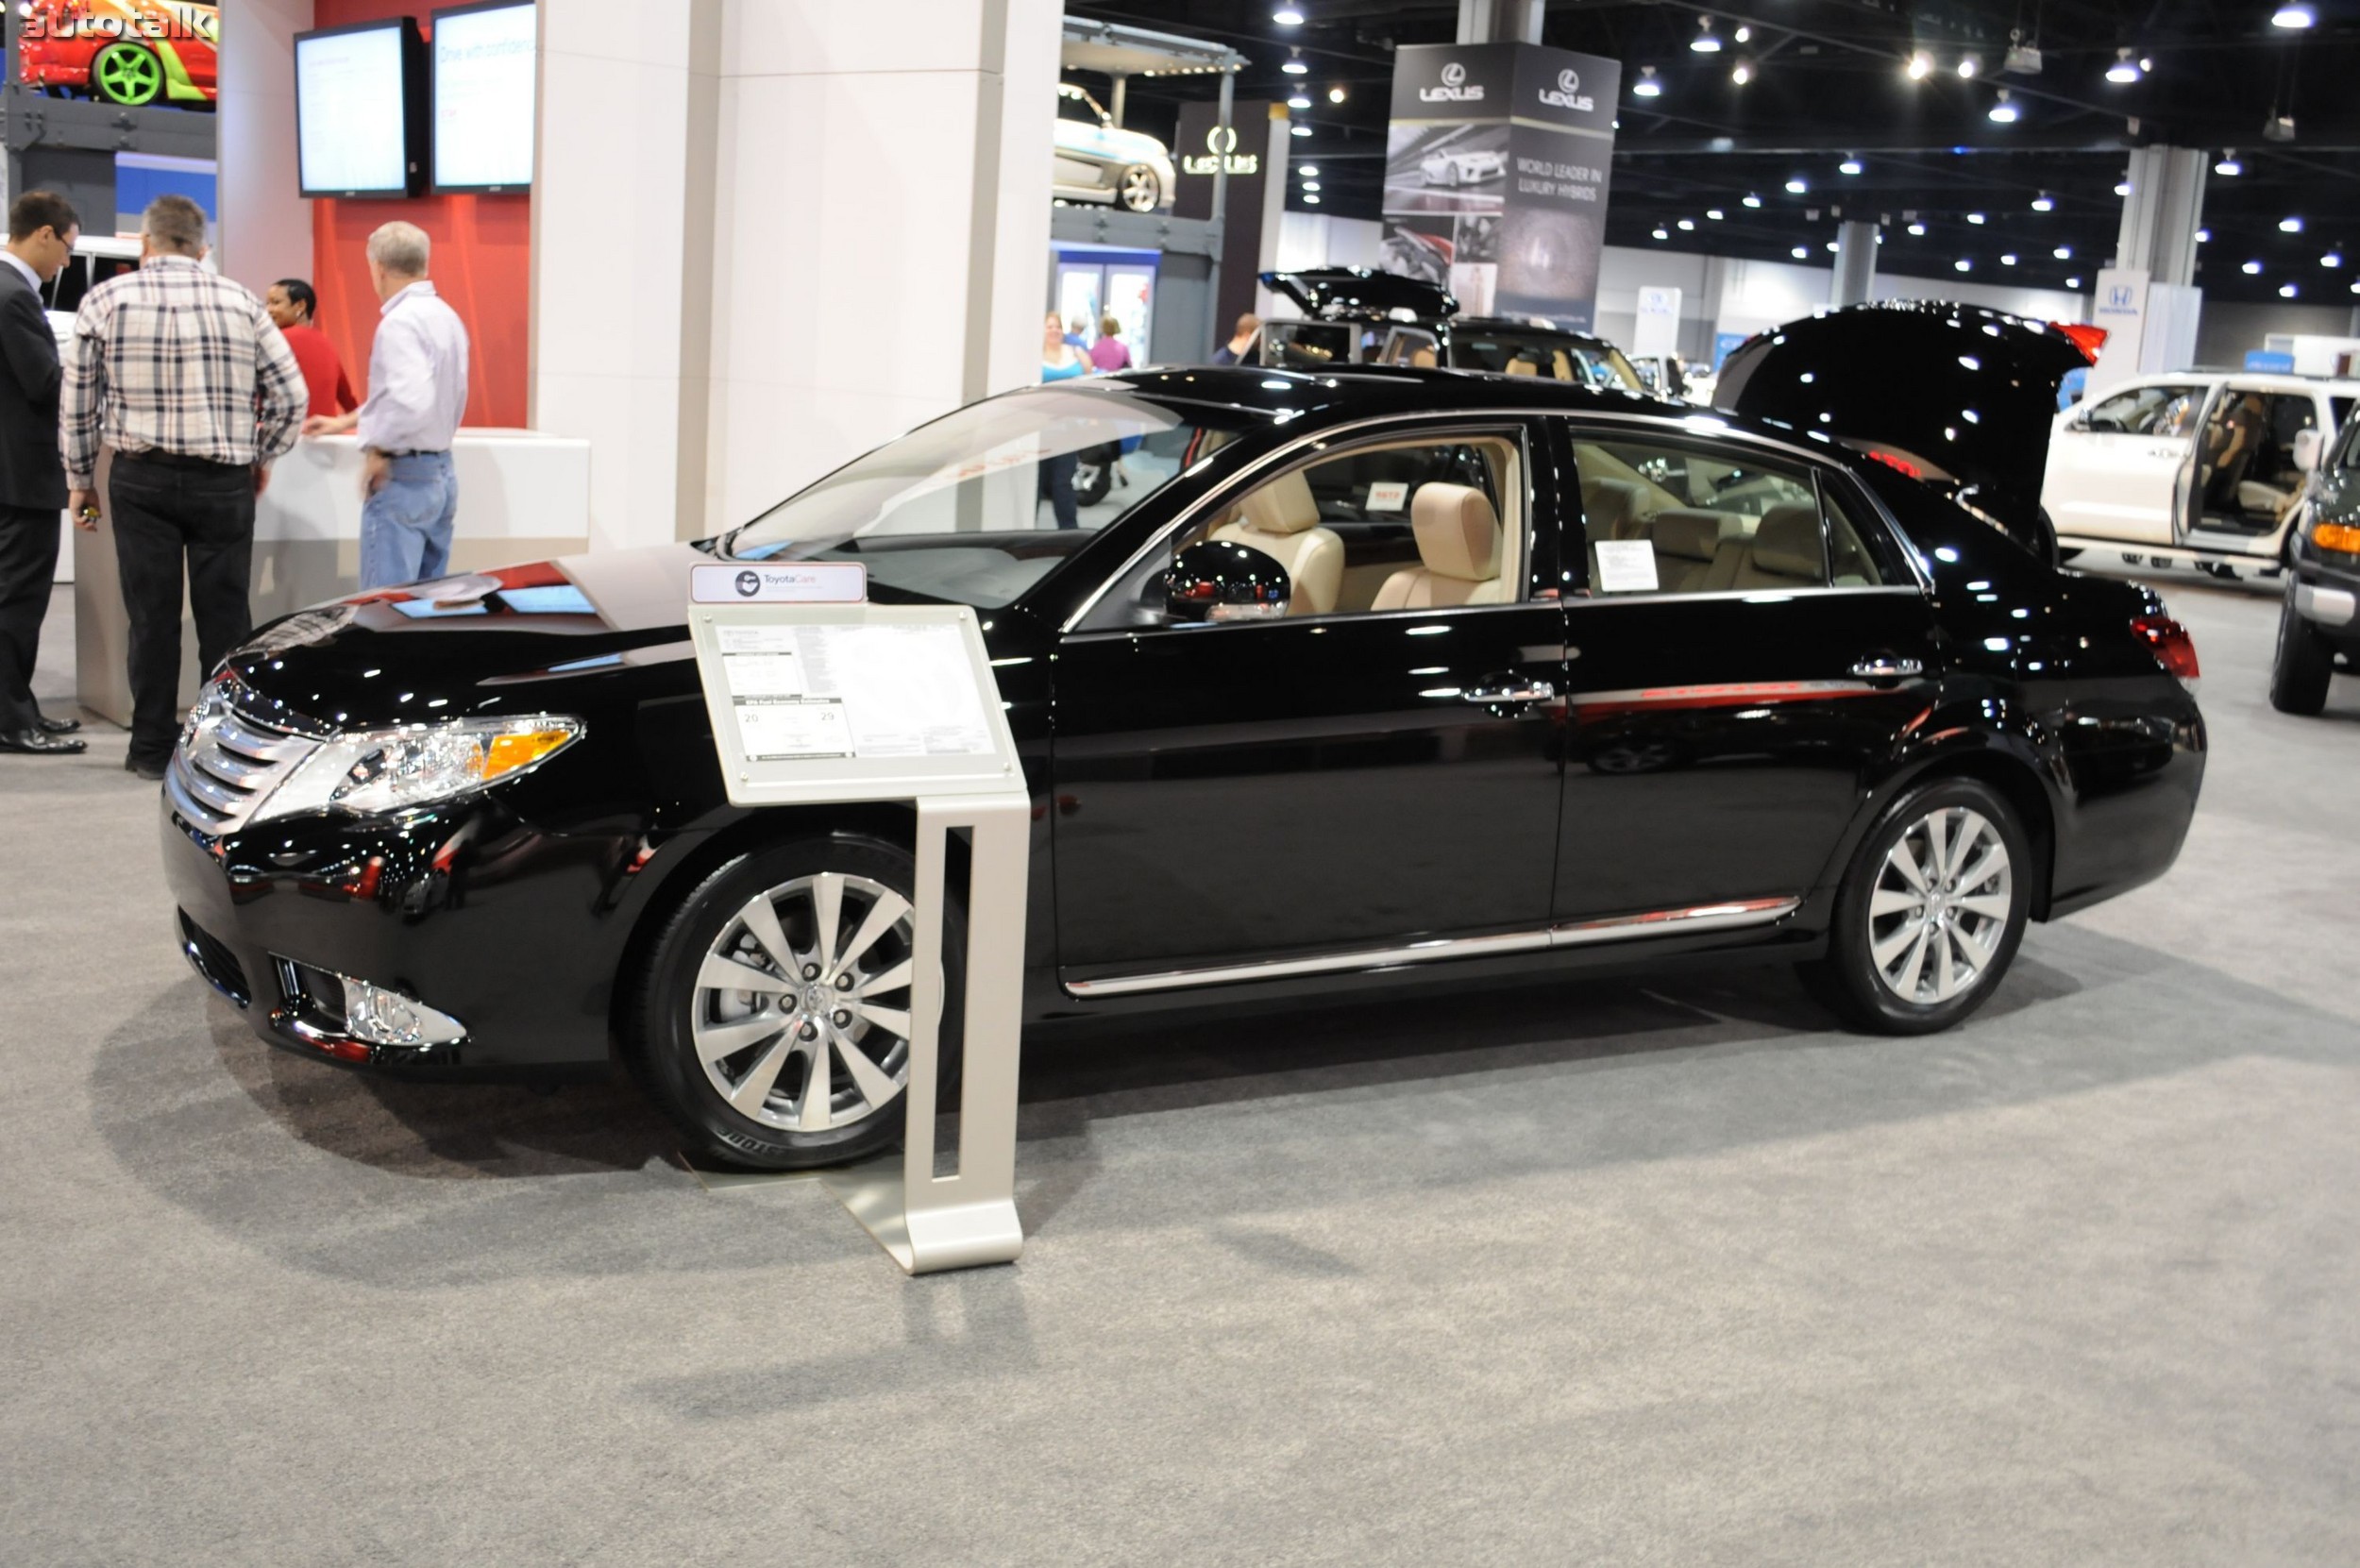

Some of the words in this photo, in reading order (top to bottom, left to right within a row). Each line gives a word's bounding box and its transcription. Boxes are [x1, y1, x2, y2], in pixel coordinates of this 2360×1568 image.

[1419, 85, 1484, 103] LEXUS
[1538, 88, 1594, 112] LEXUS
[1516, 157, 1553, 177] WORLD
[1554, 162, 1589, 182] LEADER
[1590, 168, 1602, 183] IN
[1518, 177, 1555, 195] LUXURY
[1557, 182, 1597, 202] HYBRIDS
[764, 574, 816, 585] ToyotaCare
[744, 714, 759, 723] 20
[821, 712, 834, 721] 29
